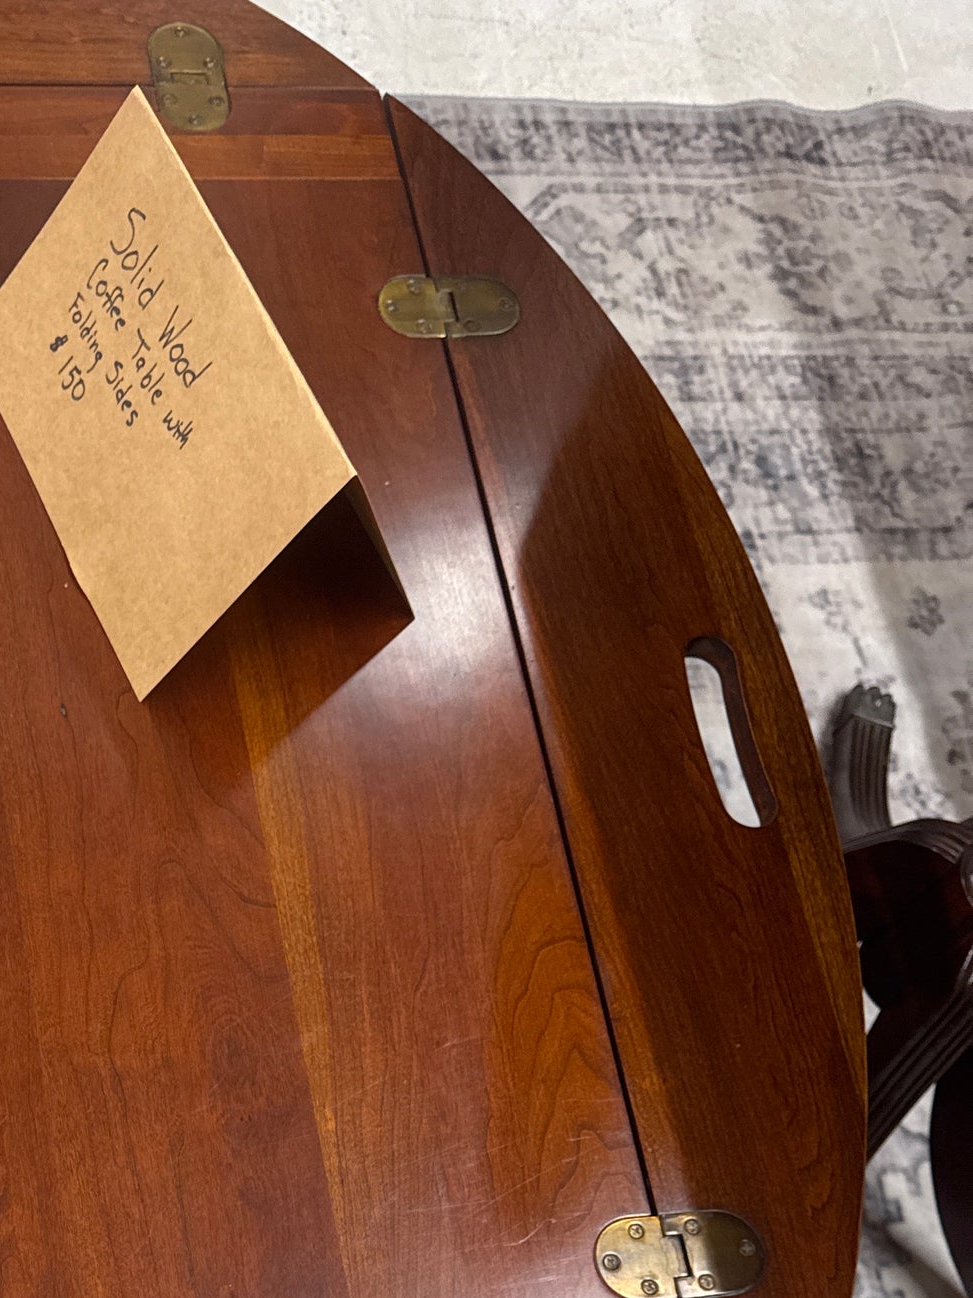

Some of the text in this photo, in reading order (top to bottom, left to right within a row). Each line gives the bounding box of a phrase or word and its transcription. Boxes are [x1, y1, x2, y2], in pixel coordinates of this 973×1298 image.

[68, 291, 140, 427] Folding Sides
[86, 258, 194, 451] Coffee Table with
[109, 207, 214, 389] Solid Wood
